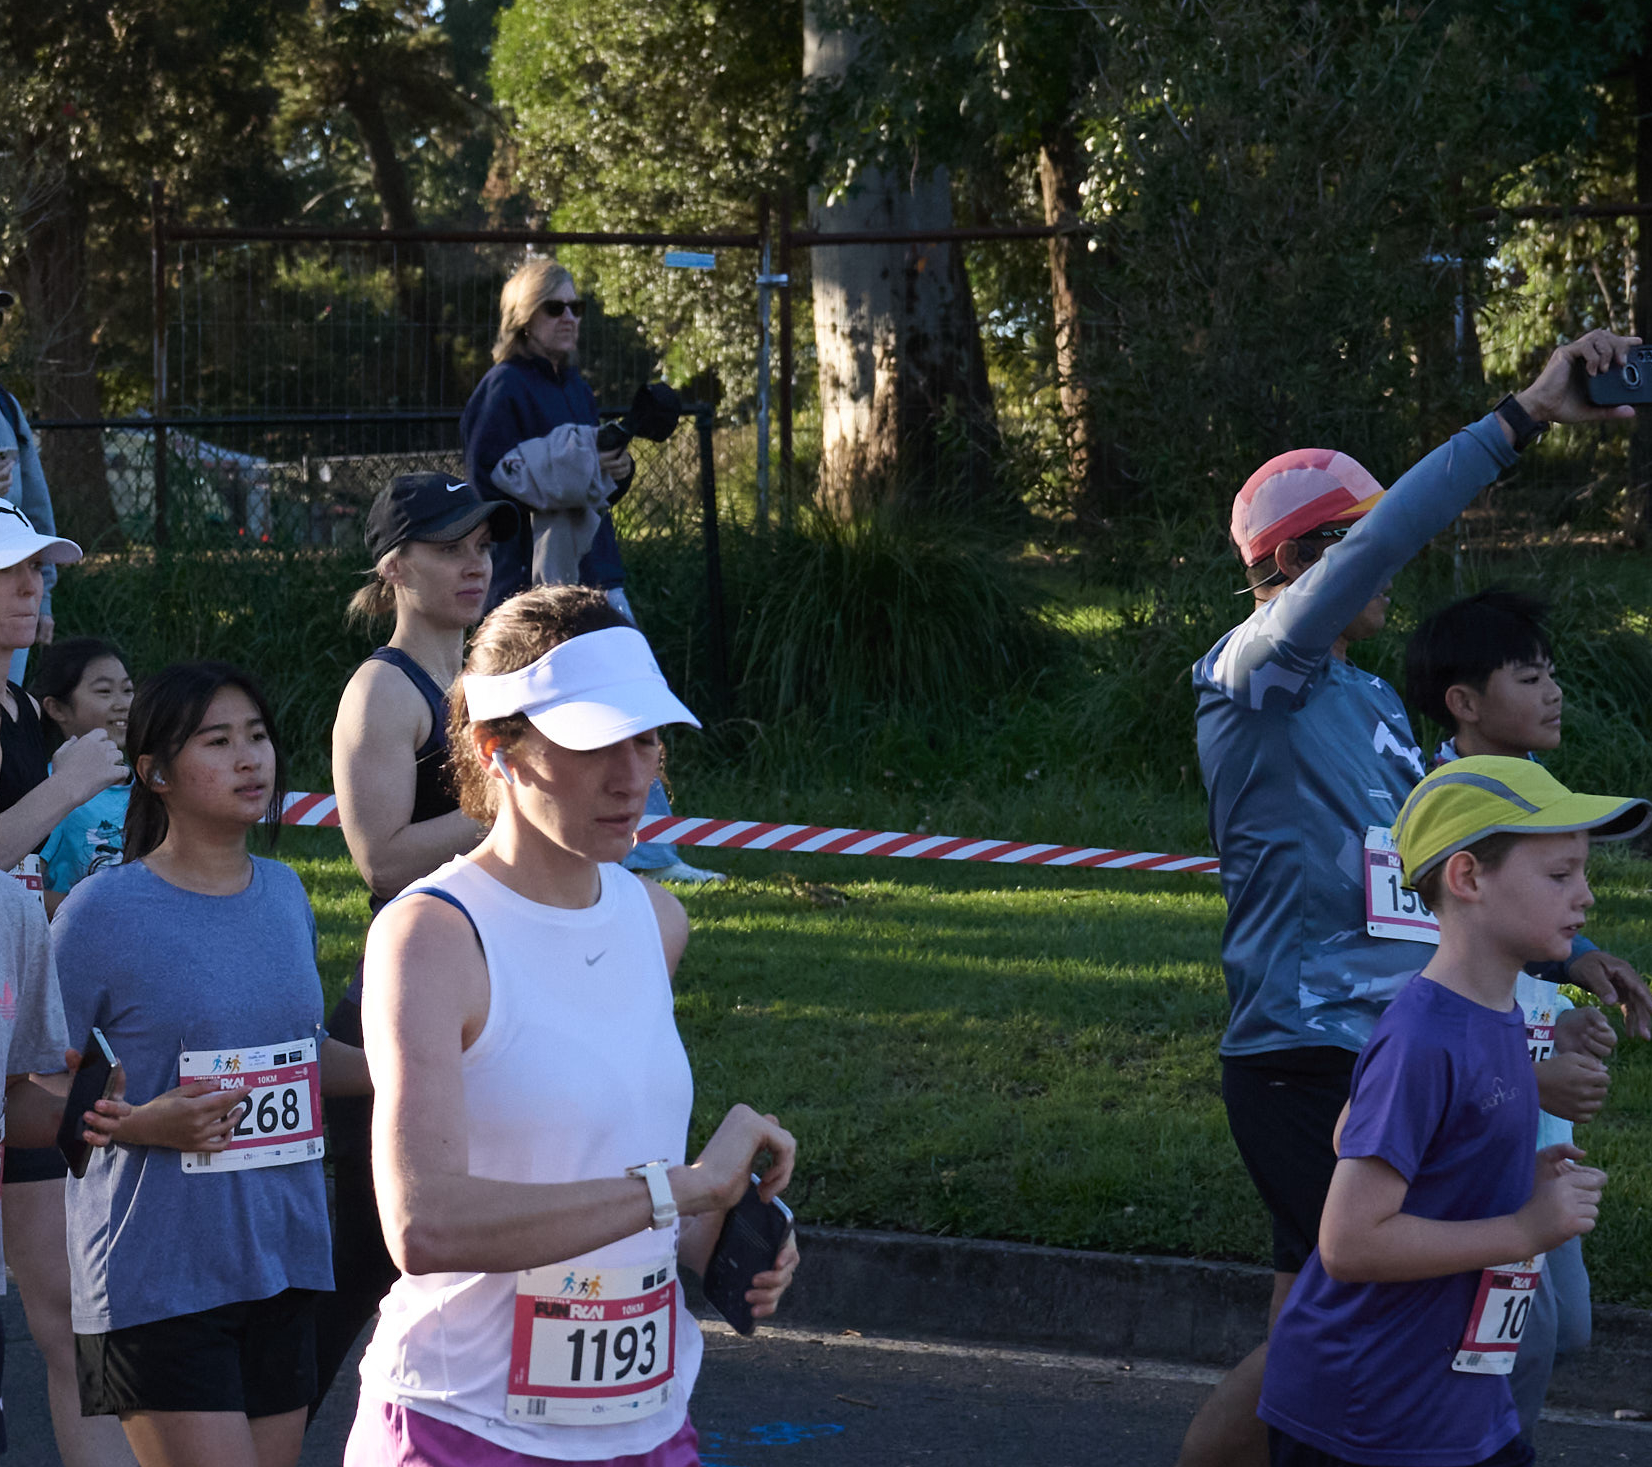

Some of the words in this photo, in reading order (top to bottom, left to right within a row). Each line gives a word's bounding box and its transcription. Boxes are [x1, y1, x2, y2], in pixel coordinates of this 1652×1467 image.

[257, 1074, 278, 1085] 10KM
[233, 1088, 300, 1137] 268
[534, 1302, 571, 1318] FUN
[569, 1303, 605, 1320] RUN
[621, 1302, 645, 1316] 10KM
[567, 1320, 656, 1382] 1193
